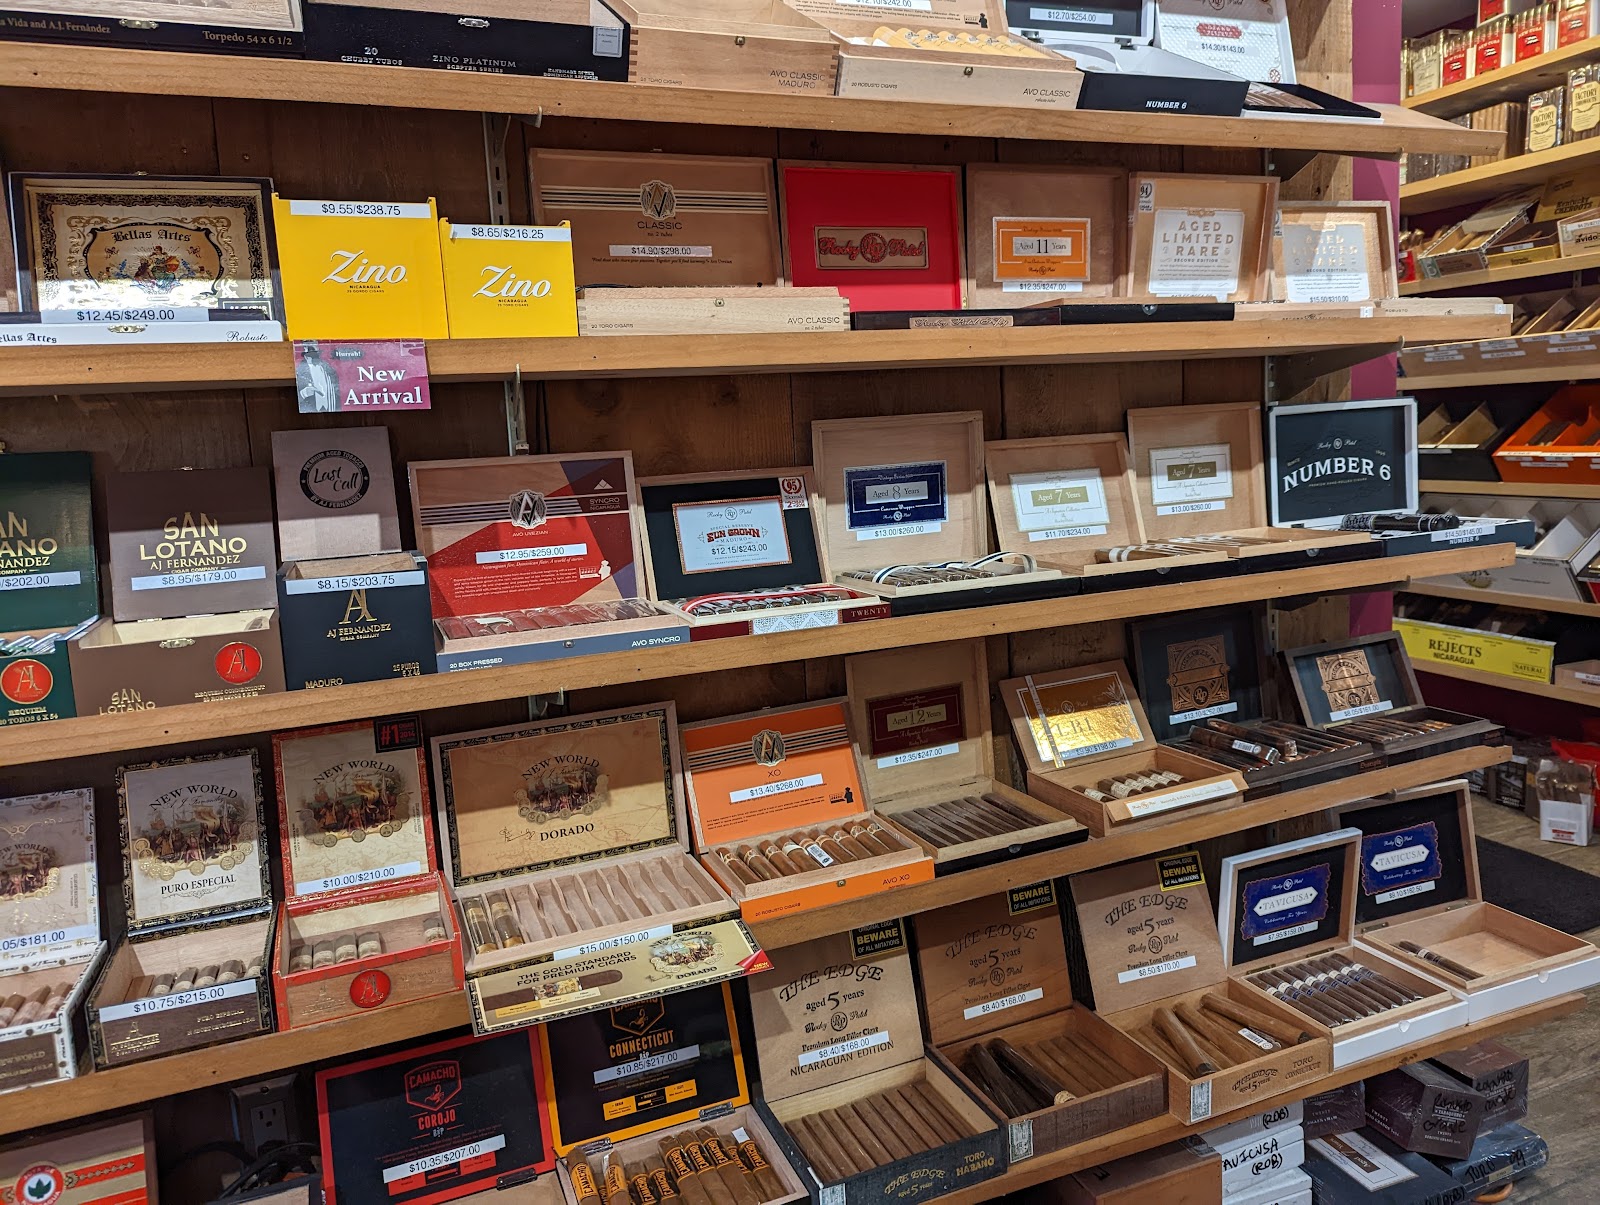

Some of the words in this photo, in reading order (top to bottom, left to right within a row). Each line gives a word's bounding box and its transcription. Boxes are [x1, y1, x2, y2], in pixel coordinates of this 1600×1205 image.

[7, 17, 28, 28] Vida
[30, 19, 47, 29] and
[49, 20, 64, 32] A.J.
[1047, 11, 1097, 22] $12.70/$254.00
[203, 30, 244, 43] Torpedo
[364, 46, 378, 56] 20
[1201, 43, 1245, 54] $14.30/$143.00
[463, 57, 517, 68] PLATINUM
[777, 79, 816, 89] MADURO
[790, 71, 826, 82] CLASSIC
[1574, 87, 1598, 101] FACTORY
[1533, 111, 1554, 123] FACTORY
[321, 203, 401, 216] $9.55/$238.75
[471, 227, 544, 240] $8.65/$216.25
[637, 220, 682, 231] CLASSIC
[1178, 220, 1222, 231] AGED
[111, 230, 152, 243] Bellas
[157, 230, 192, 242] Artes
[1162, 233, 1235, 245] LIMITED
[819, 237, 860, 260] Rocky
[887, 239, 926, 257] Patel
[1175, 245, 1219, 257] RARE
[321, 250, 405, 284] Zino
[472, 265, 550, 298] Zino
[77, 310, 175, 322] $12.45/$249.00
[0, 333, 23, 342] ellas
[26, 332, 57, 344] Artes
[226, 331, 268, 342] Robusto
[357, 366, 406, 382] New
[344, 386, 423, 405] Arrival
[313, 466, 342, 484] Last
[333, 472, 360, 493] Call
[1282, 457, 1375, 493] NUMBER
[1379, 464, 1392, 481] 6
[1038, 493, 1053, 503] Aged
[1055, 489, 1063, 503] 7
[1171, 503, 1212, 513] $13.00/$260.00
[164, 512, 220, 540] SAN
[875, 526, 924, 537] $13.00/$260.00
[1045, 528, 1091, 538] $11.70/$234.00
[140, 537, 247, 560] LOTANO
[499, 547, 564, 560] $12.95/$259.00
[711, 544, 768, 555] $12.15/$243.00
[150, 561, 162, 571] AJ
[167, 555, 240, 568] FERNANDEZ
[161, 571, 237, 585] $8.95/$179.00
[317, 575, 395, 590] $8.15/$203.75
[850, 607, 888, 617] TWENTY
[1429, 639, 1482, 658] REJECTS
[1433, 652, 1475, 666] NICARAGUA
[304, 677, 343, 690] MADURO
[111, 689, 142, 705] SAN
[895, 747, 943, 764] $12.35/$247.00
[313, 763, 344, 784] NEW
[348, 760, 395, 774] WORLD
[522, 761, 552, 780] NEW
[555, 754, 600, 769] WORLD
[749, 779, 804, 797] $13.40/$268.00
[150, 789, 183, 811] NEW
[187, 784, 239, 799] WORLD
[539, 822, 595, 842] DORADO
[1379, 849, 1422, 866] TAVICUSA
[322, 867, 395, 888] $10.00/$210.00
[1163, 864, 1197, 878] BEWARE
[161, 881, 188, 895] PURO
[191, 874, 237, 889] ESPECIAL
[1013, 885, 1050, 902] BEWARE
[1263, 892, 1309, 911] TAVICUSA
[1105, 898, 1137, 927] THE
[1139, 892, 1188, 911] EDGE
[1127, 923, 1144, 935] aged
[1144, 918, 1155, 936] 5
[1156, 916, 1174, 928] years
[0, 931, 65, 951] .05/$181.00
[580, 931, 649, 955] $15.00/$150.00
[673, 930, 712, 942] WORLD
[856, 928, 898, 945] BEWARE
[946, 929, 982, 959] THE
[985, 923, 1038, 940] EDGE
[519, 970, 542, 980] THE
[543, 964, 571, 978] GOLD
[574, 951, 631, 971] STANDARD
[970, 956, 987, 969] aged
[989, 949, 1000, 968] 5
[1001, 947, 1021, 961] years
[517, 976, 541, 987] FOR
[543, 965, 596, 984] PREMIUM
[598, 953, 637, 971] CIGARS
[676, 966, 718, 980] DORADO
[779, 971, 820, 1002] THE
[825, 963, 884, 982] EDGE
[133, 987, 225, 1013] $10.75/$215.00
[806, 999, 826, 1011] aged
[827, 991, 840, 1010] 5
[842, 988, 865, 1003] years
[981, 992, 1027, 1013] $8.40/$168.00
[609, 1030, 674, 1058] CONNECTICUT
[818, 1037, 870, 1059] $8.40/$168.00
[616, 1052, 678, 1076] $10.85/$217.00
[790, 1053, 854, 1077] NICARAGUAN
[857, 1040, 895, 1059] EDITION
[1292, 1056, 1313, 1068] TORO
[409, 1066, 456, 1088] CAMACHO
[418, 1109, 456, 1130] COROJO
[1262, 1106, 1290, 1130] (ROB)
[409, 1144, 481, 1173] $10.35/$207.00
[964, 1151, 986, 1163] TORO
[1251, 1153, 1283, 1176] (ROB)
[956, 1157, 996, 1177] HABANO
[884, 1174, 909, 1196] THE
[911, 1168, 946, 1181] EDGE
